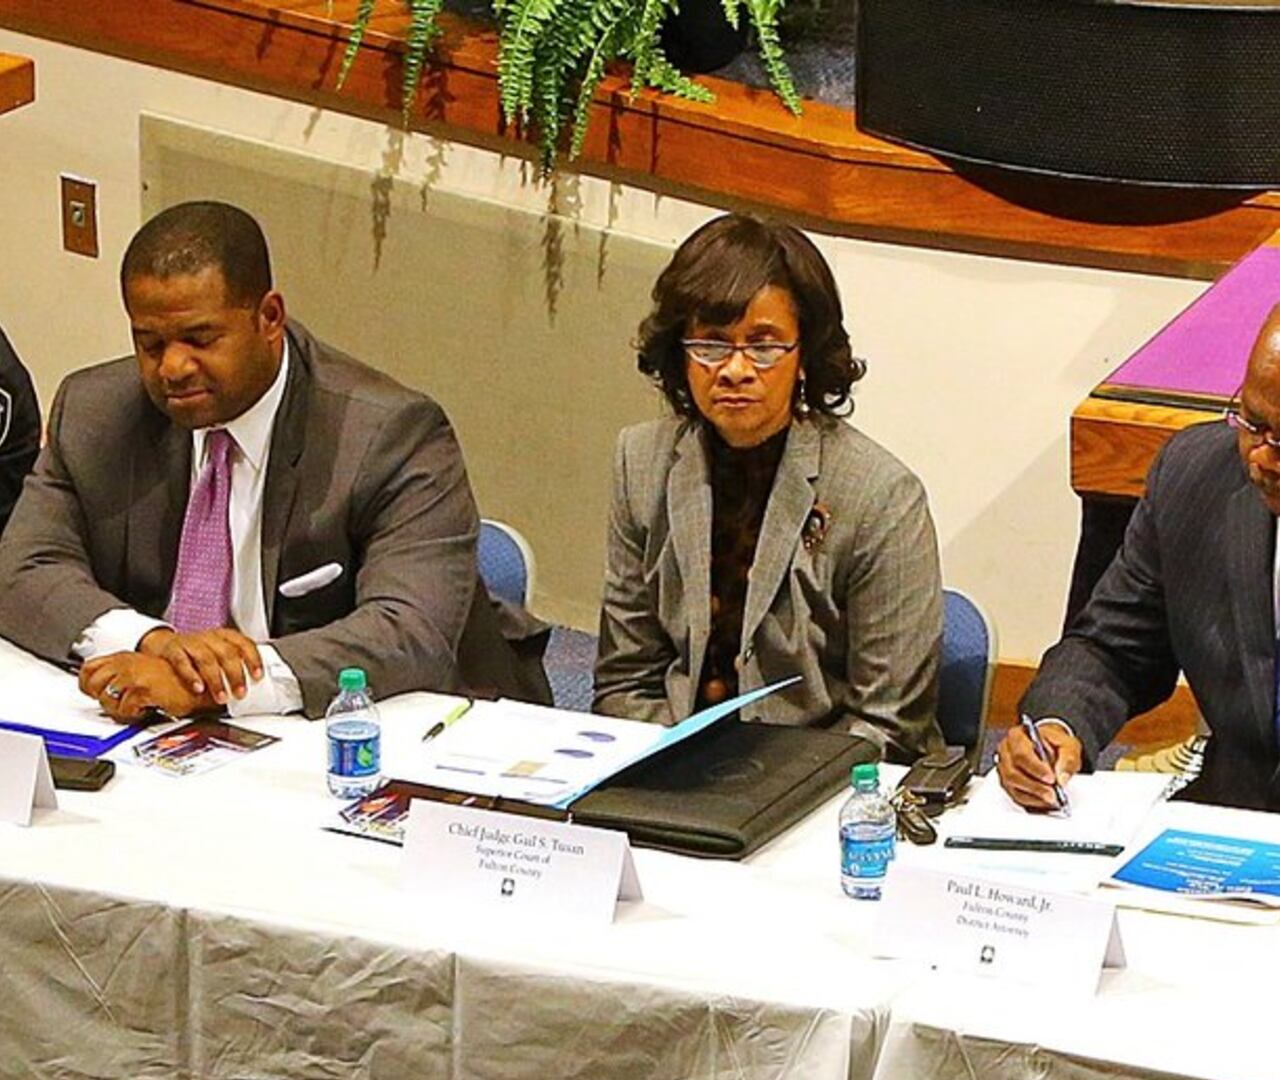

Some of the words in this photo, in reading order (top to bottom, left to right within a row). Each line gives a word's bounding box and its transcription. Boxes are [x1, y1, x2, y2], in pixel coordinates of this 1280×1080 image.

[449, 823, 479, 838] Chief
[480, 828, 510, 844] Judge
[513, 832, 537, 846] Gail
[476, 846, 512, 859] Superior
[514, 851, 541, 862] Court
[478, 859, 508, 872] Fulton
[510, 865, 542, 879] County
[947, 880, 974, 895] Paul
[1038, 899, 1054, 913] Jr.
[963, 901, 994, 915] Fulton
[996, 908, 1029, 922] County
[957, 915, 989, 929] District
[993, 921, 1030, 937] Attorney
